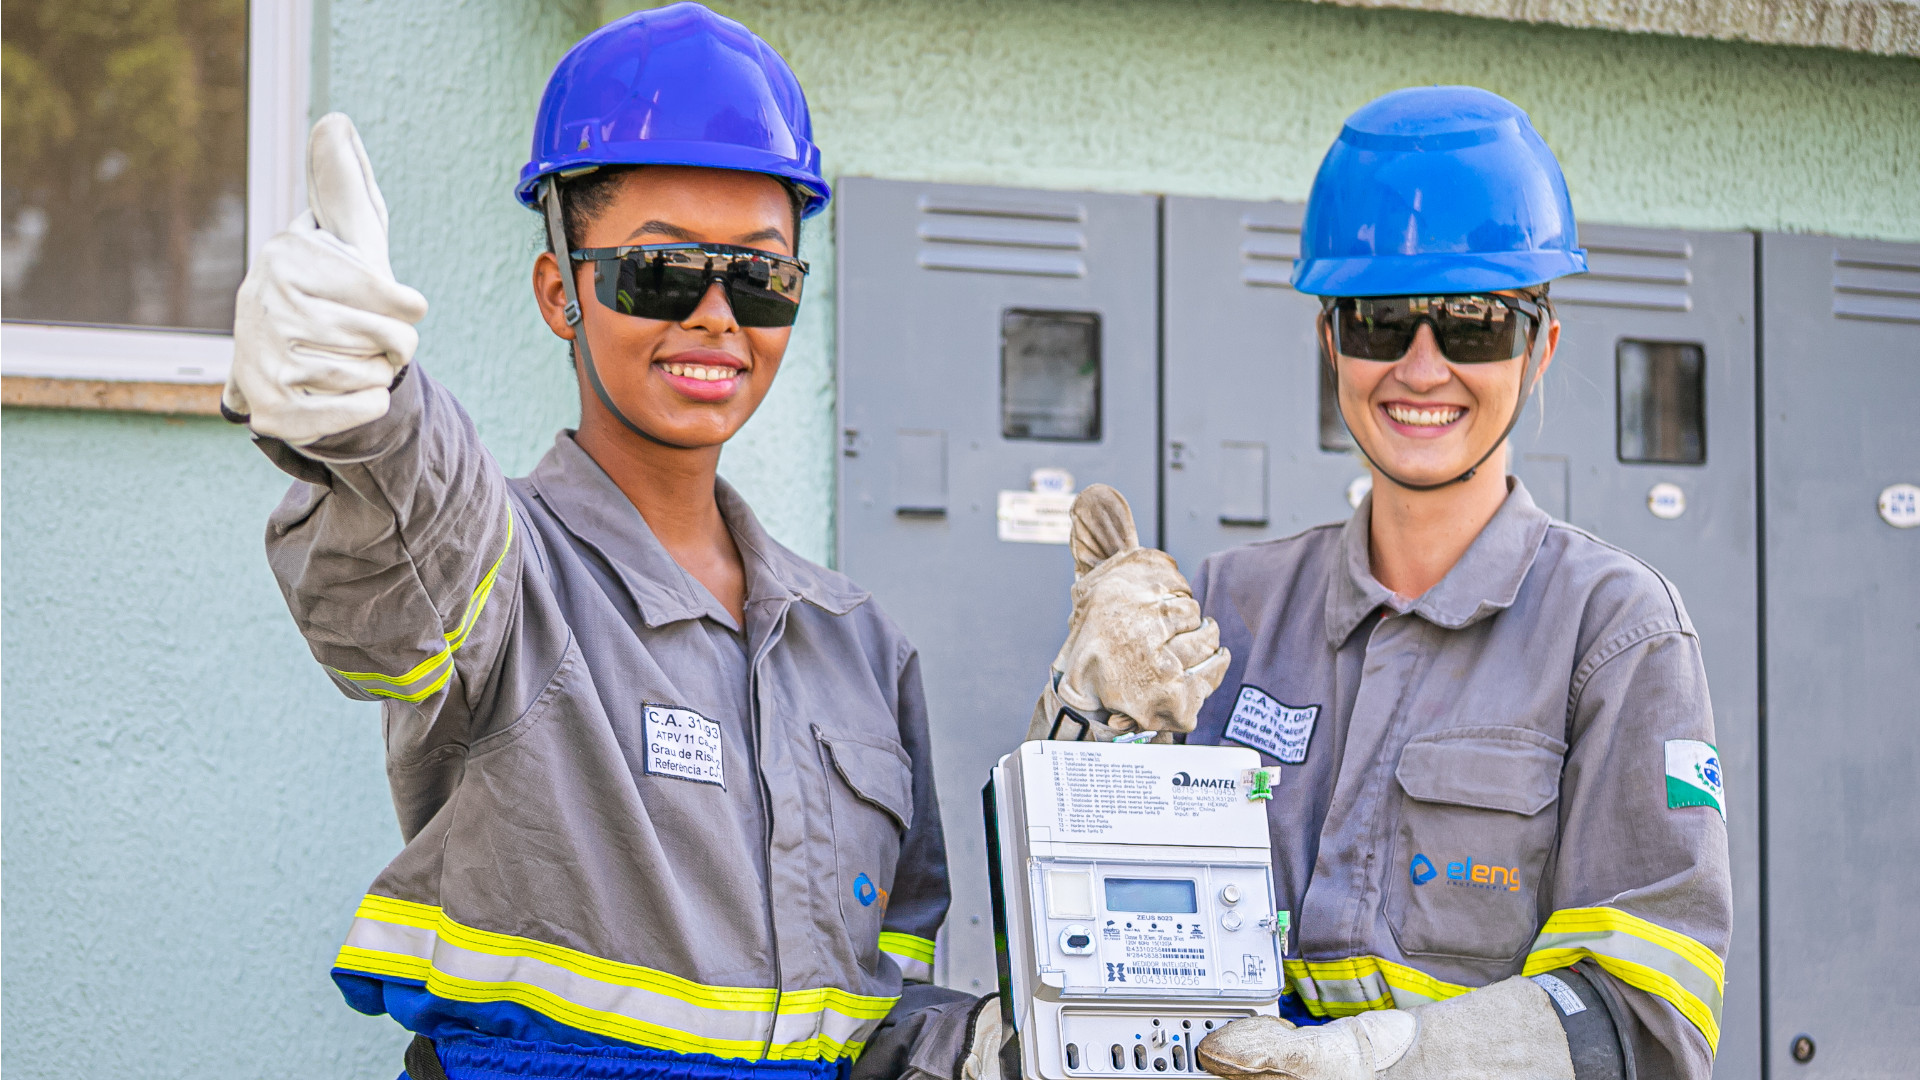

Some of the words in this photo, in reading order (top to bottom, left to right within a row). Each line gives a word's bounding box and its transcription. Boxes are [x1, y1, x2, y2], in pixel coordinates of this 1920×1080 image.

[1243, 690, 1270, 710] C.A.
[650, 711, 682, 727] C.A.
[1234, 714, 1257, 728] Grau
[1260, 726, 1272, 734] de
[1242, 705, 1267, 719] ATPV
[1270, 717, 1277, 726] 11
[657, 730, 681, 742] ATPV
[685, 735, 694, 743] 11
[651, 743, 676, 756] Grau
[679, 749, 691, 759] de
[696, 750, 715, 762] Ris
[1191, 778, 1236, 789] ANATEL
[1446, 856, 1520, 891] eleng
[1135, 975, 1199, 985] 0043310256
